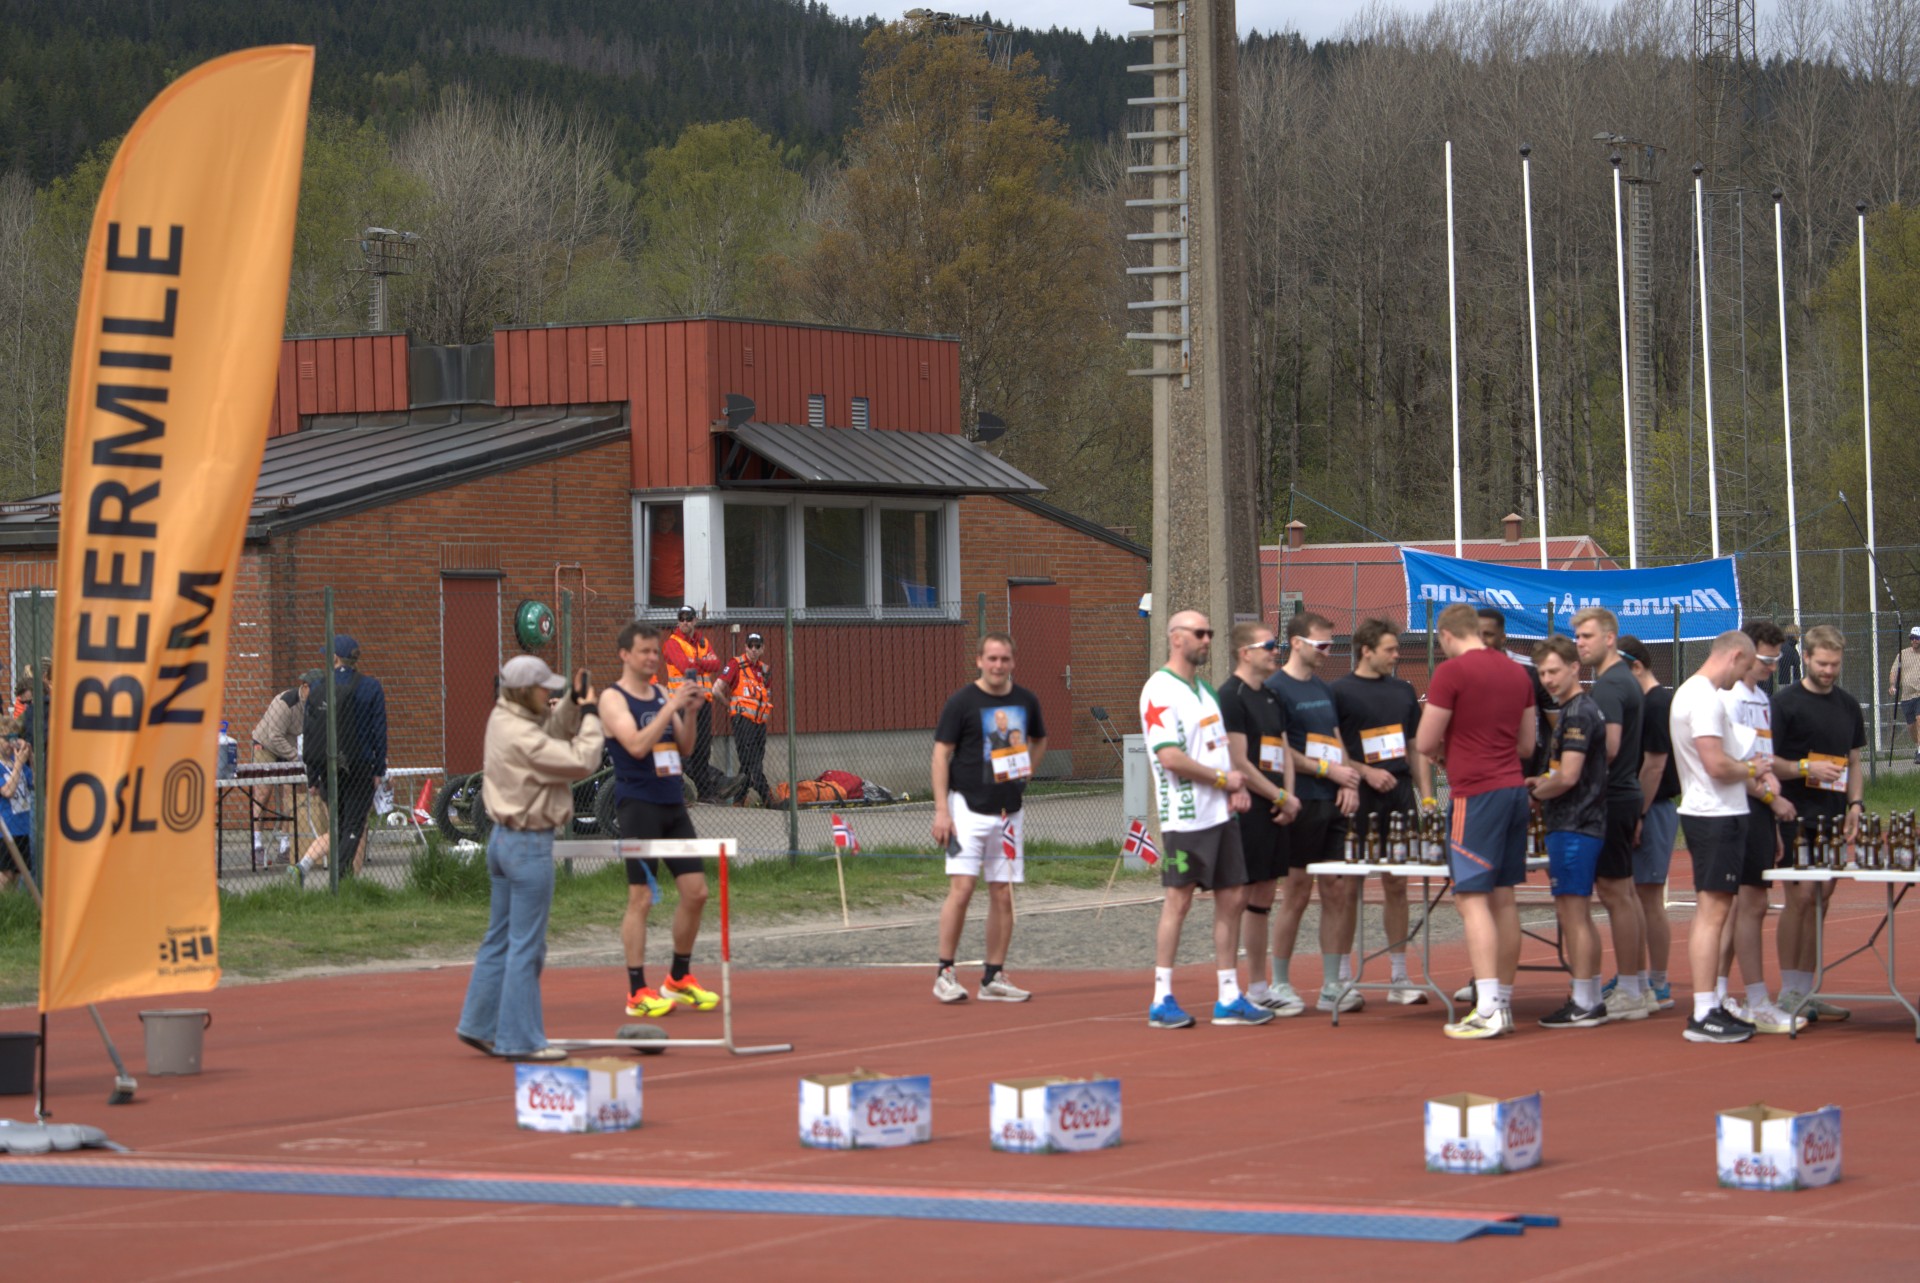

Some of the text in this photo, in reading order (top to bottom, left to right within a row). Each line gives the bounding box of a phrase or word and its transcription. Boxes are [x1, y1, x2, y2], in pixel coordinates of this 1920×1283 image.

[72, 222, 183, 732] BEERMILE
[147, 569, 223, 726] NM
[59, 758, 205, 843] OSLO
[528, 1083, 575, 1112] Coors
[867, 1098, 919, 1127] Coors
[1059, 1101, 1111, 1131] Coors
